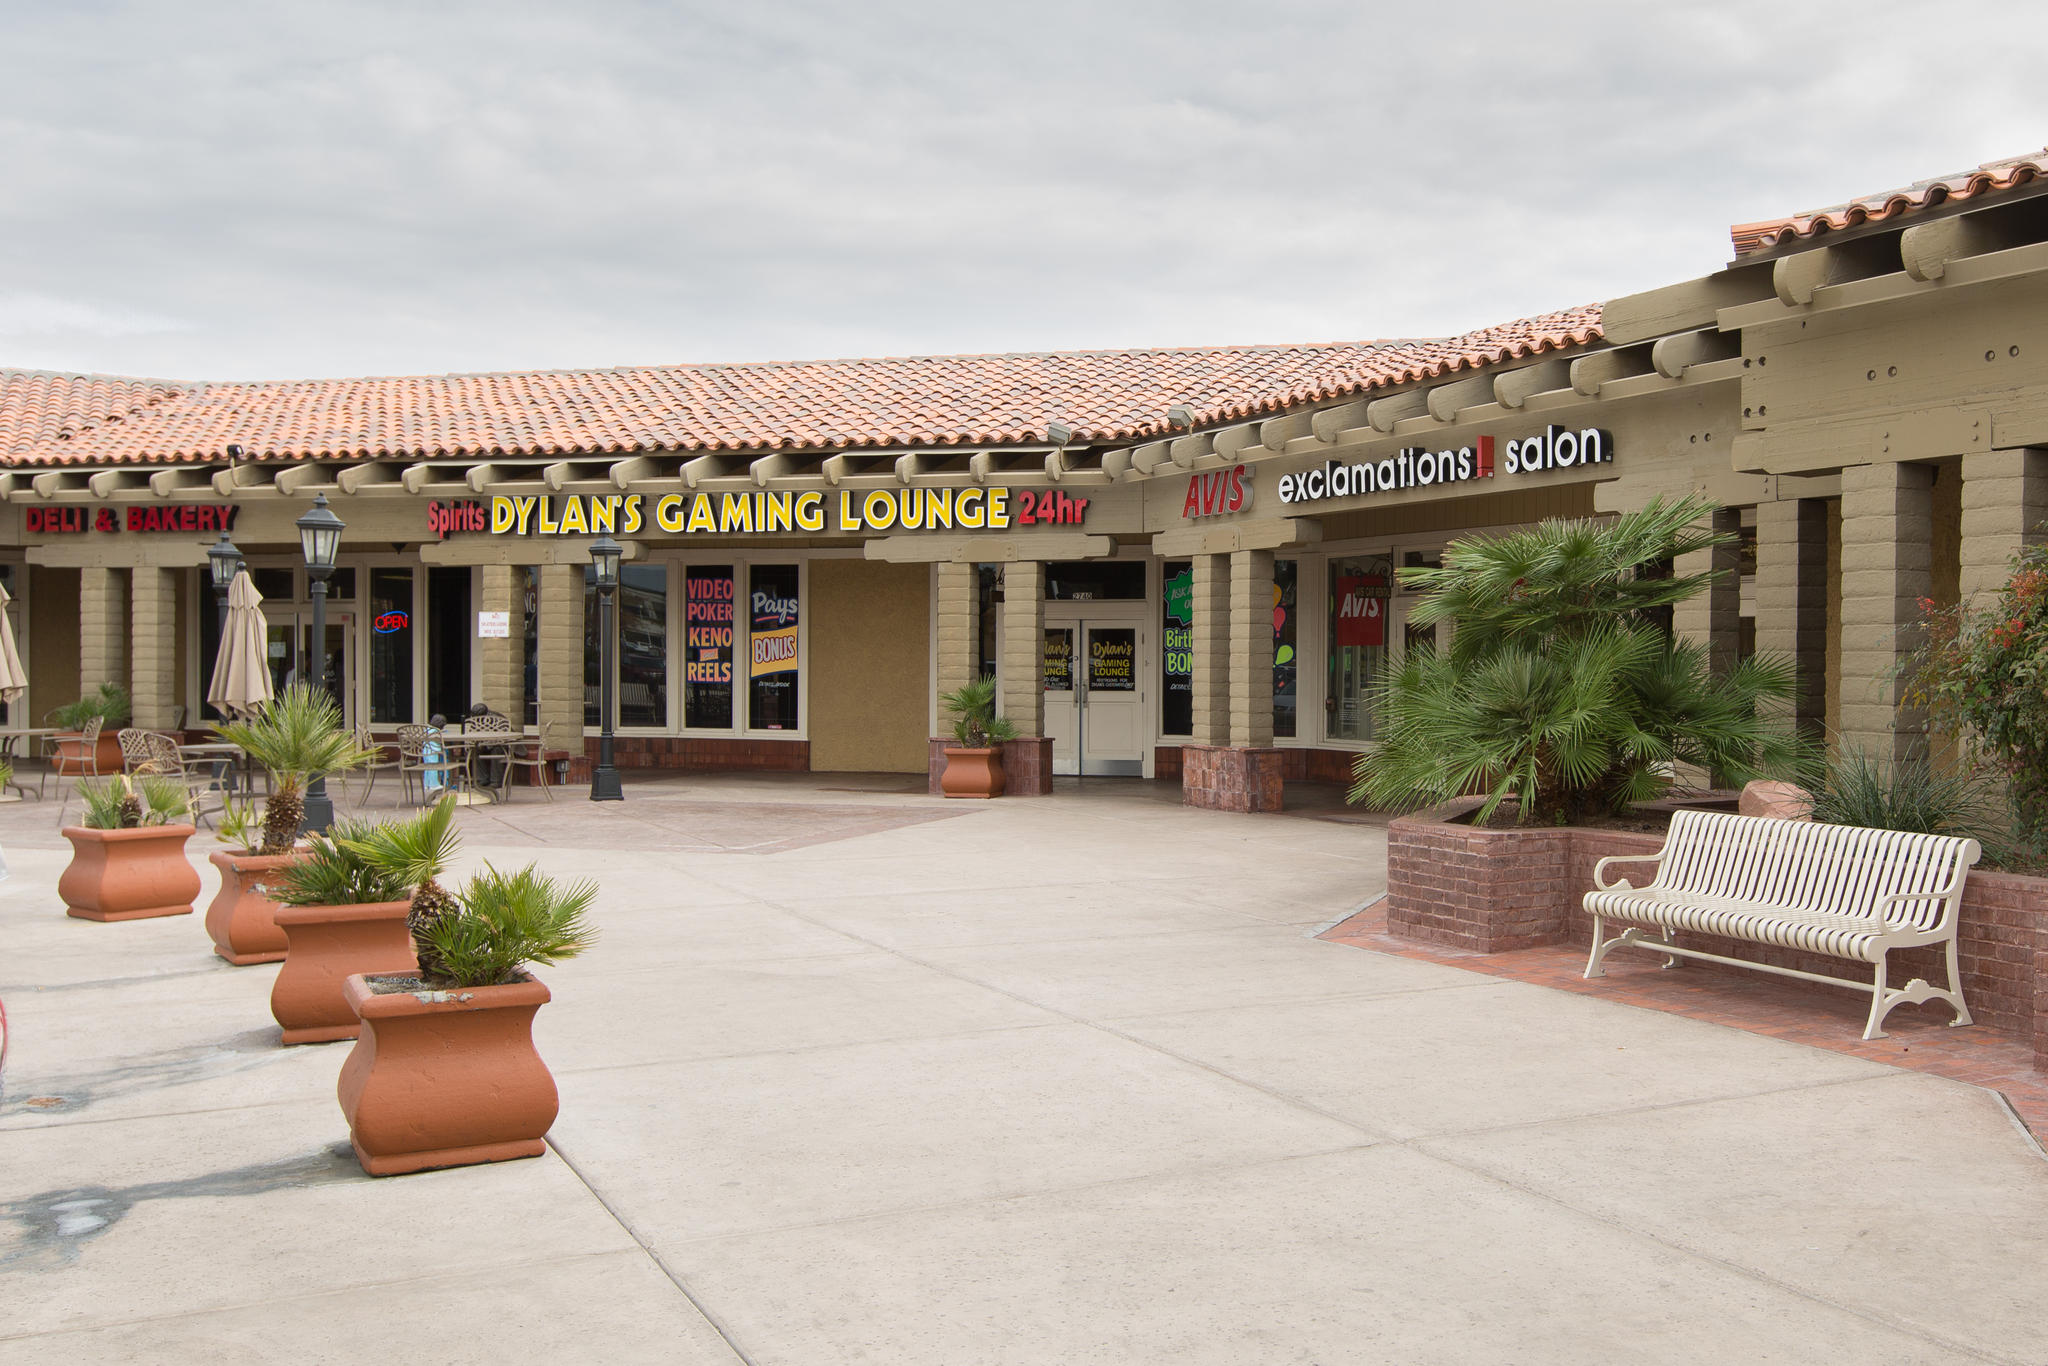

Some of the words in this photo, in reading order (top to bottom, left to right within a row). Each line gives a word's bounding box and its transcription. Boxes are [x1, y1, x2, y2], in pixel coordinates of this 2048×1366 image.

[1504, 423, 1601, 474] salon
[1182, 464, 1246, 519] AVIS
[26, 506, 83, 533] DELI
[95, 507, 115, 533] &
[127, 504, 236, 532] BAKERY
[427, 500, 486, 540] Spirits
[491, 494, 642, 536] DYLAN'S
[656, 490, 825, 533] GAMING
[839, 487, 1010, 531] LOUNGE
[1017, 490, 1088, 524] 24hr
[687, 578, 734, 600] VIDEO
[687, 602, 733, 621] POKER
[752, 592, 798, 624] Pays
[1340, 593, 1380, 618] AVIS
[375, 615, 408, 629] OPEN
[689, 627, 733, 647] KENO
[754, 635, 796, 664] BONUS
[1044, 641, 1071, 656] lan's
[1093, 641, 1132, 658] Dylan's
[687, 662, 731, 682] REELS
[1044, 659, 1068, 668] MING
[1044, 667, 1068, 676] UNGE
[1094, 659, 1130, 667] GAMING
[1095, 668, 1130, 676] LOUNGE
